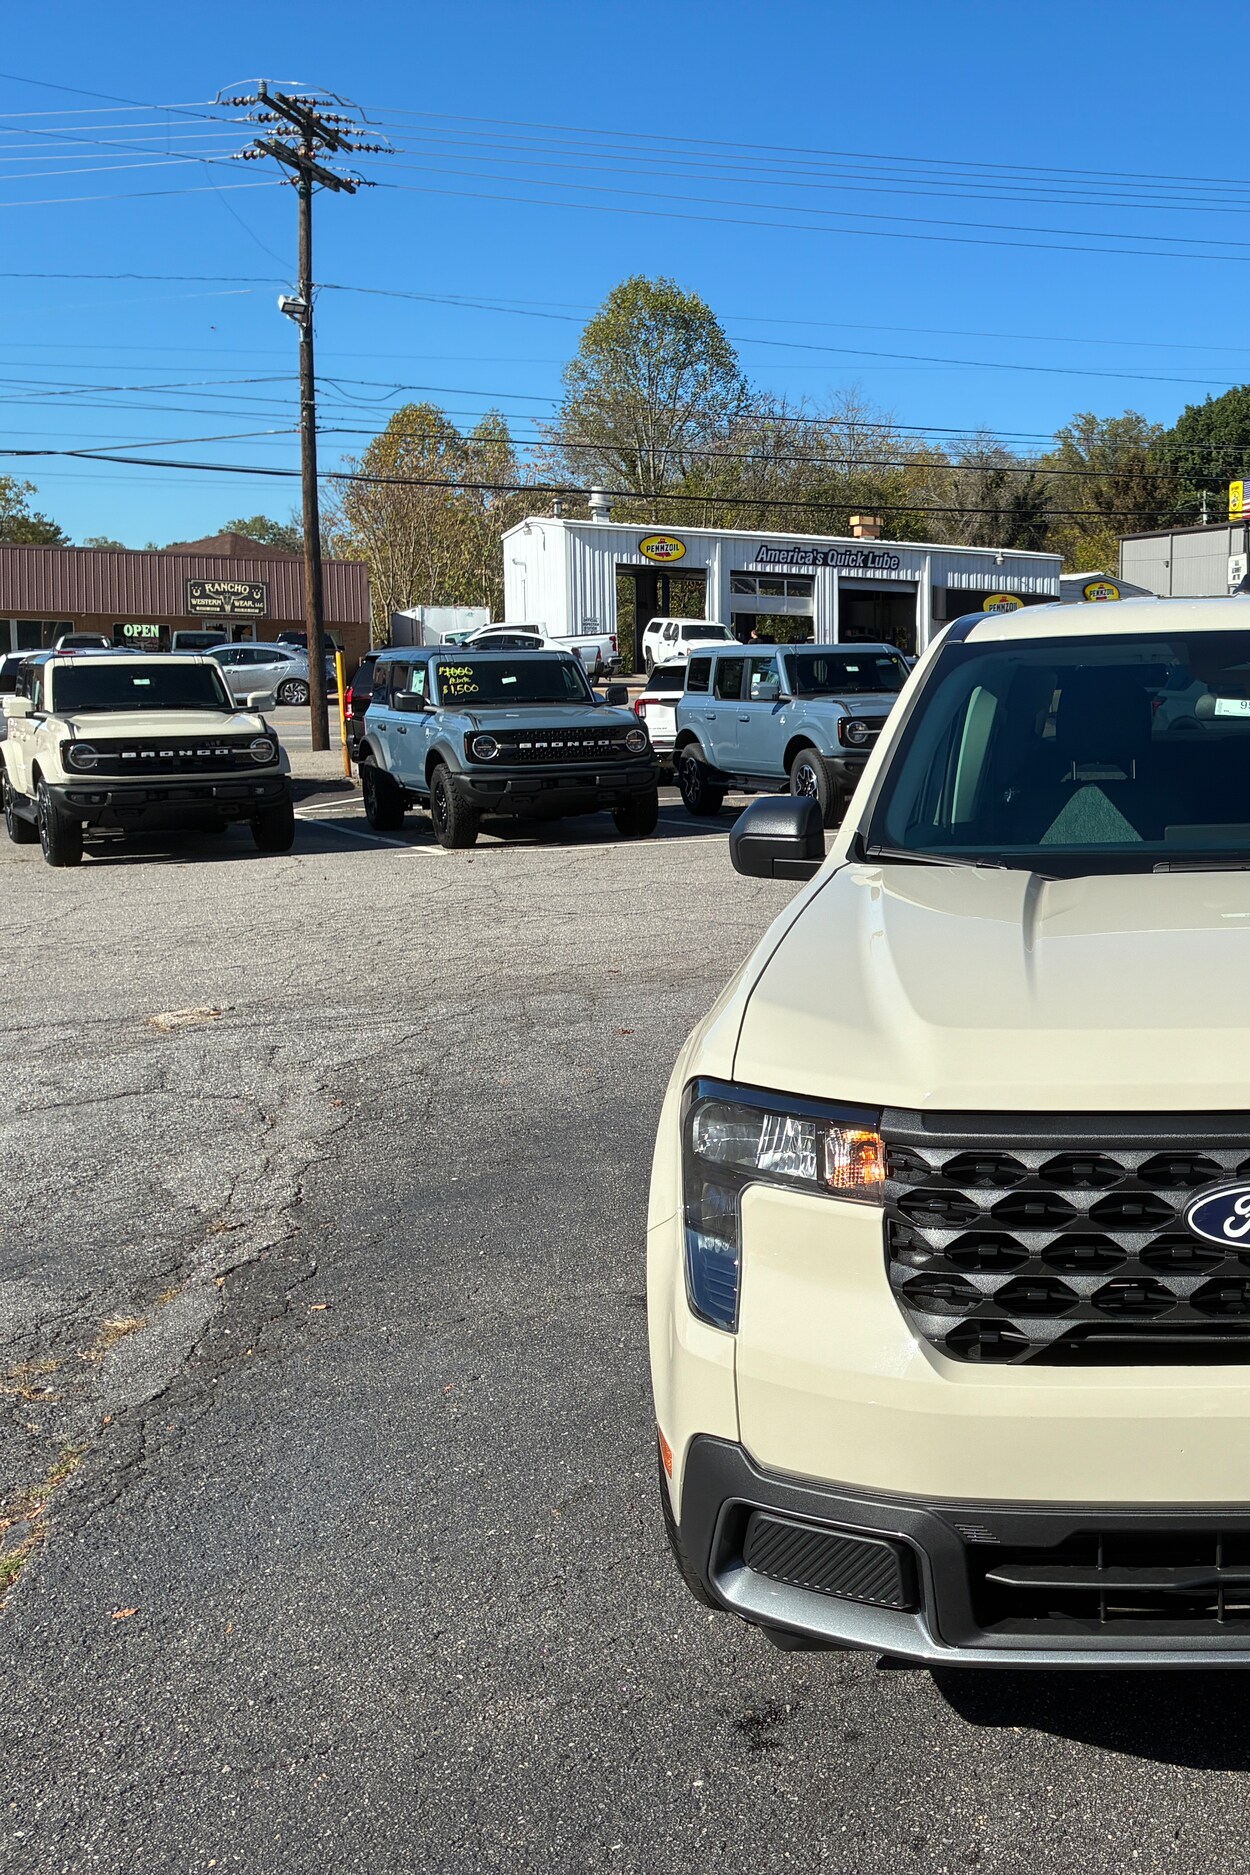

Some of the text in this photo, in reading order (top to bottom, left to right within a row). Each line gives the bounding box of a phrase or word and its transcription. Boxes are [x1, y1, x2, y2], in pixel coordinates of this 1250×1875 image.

[646, 544, 680, 552] PENNZOIL
[757, 546, 899, 569] America's Quick Lube
[205, 583, 249, 594] RANCHO
[191, 598, 222, 606] WESTERN
[123, 624, 159, 638] OPEN
[442, 683, 479, 696] $1,500
[519, 740, 610, 749] BRONCO
[121, 749, 229, 759] BRONCO
